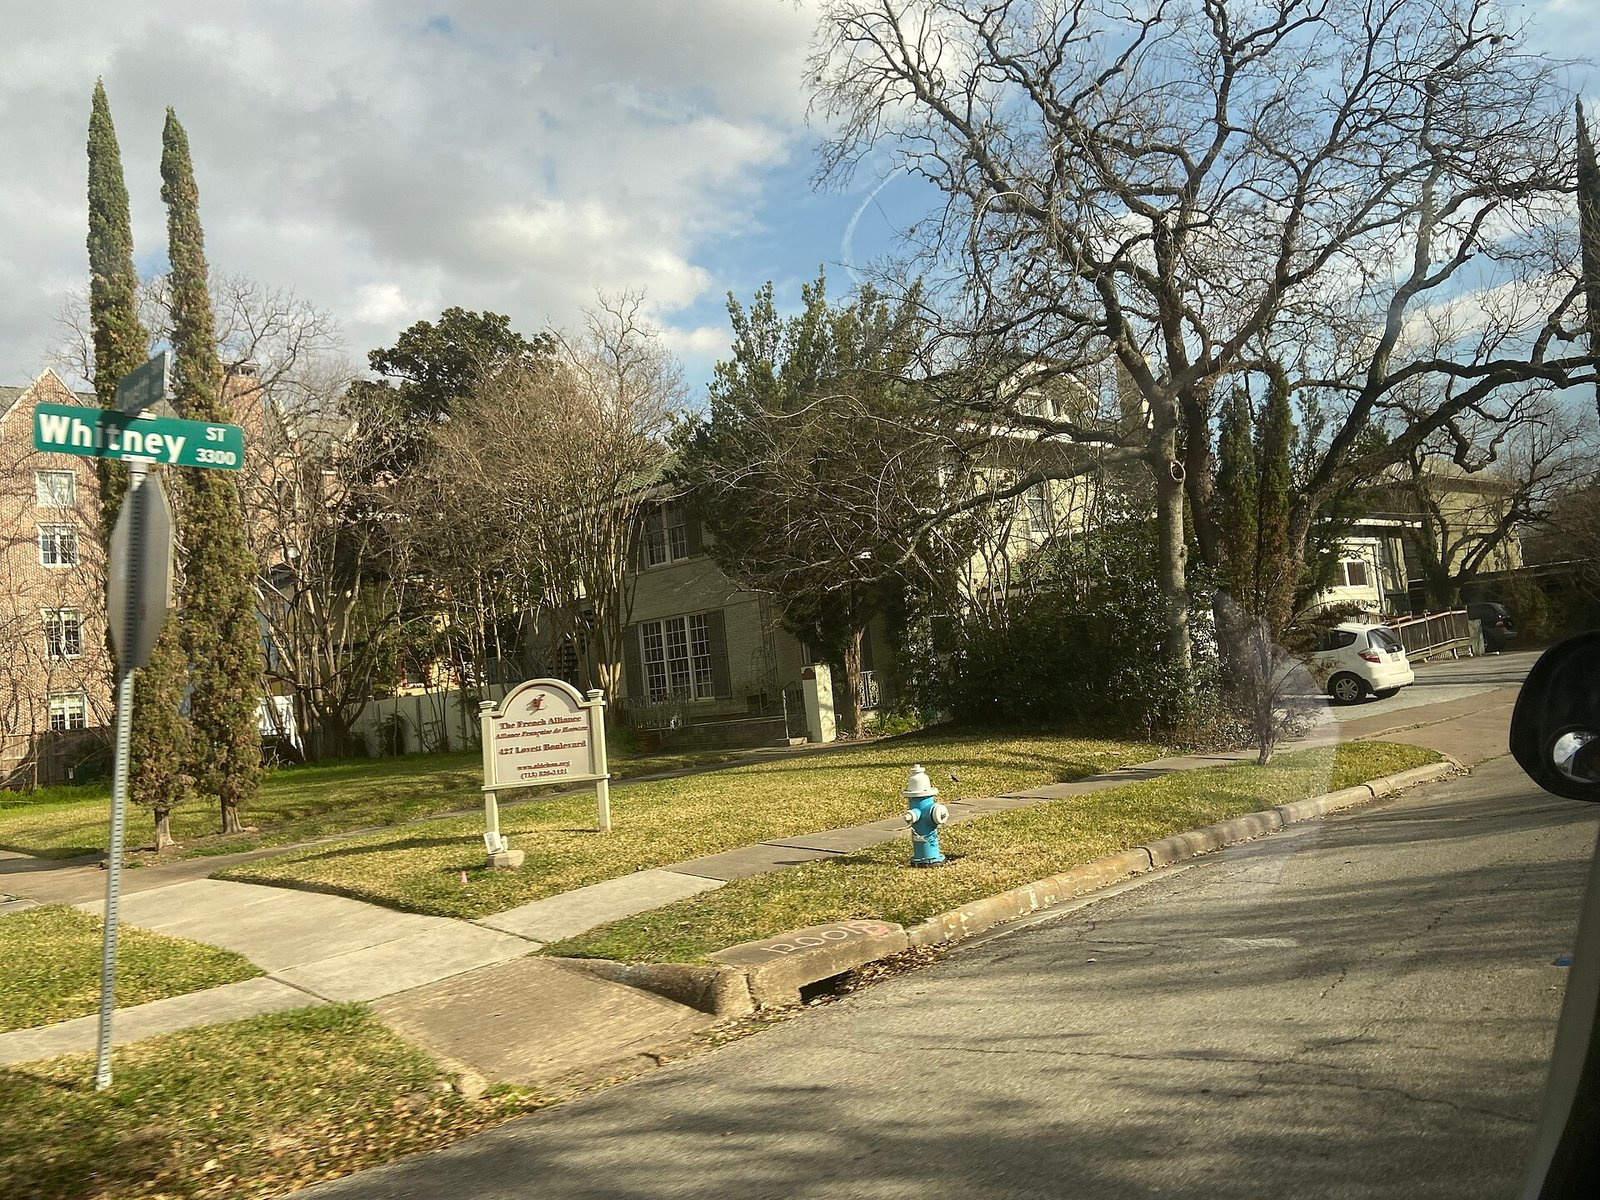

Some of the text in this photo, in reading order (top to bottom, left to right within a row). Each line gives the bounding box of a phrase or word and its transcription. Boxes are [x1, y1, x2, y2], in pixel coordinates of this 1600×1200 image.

[38, 412, 227, 464] Whitney ST
[195, 447, 237, 466] 3300
[499, 715, 582, 730] The French Alliance
[498, 739, 587, 756] 427 Lovett Boulevard
